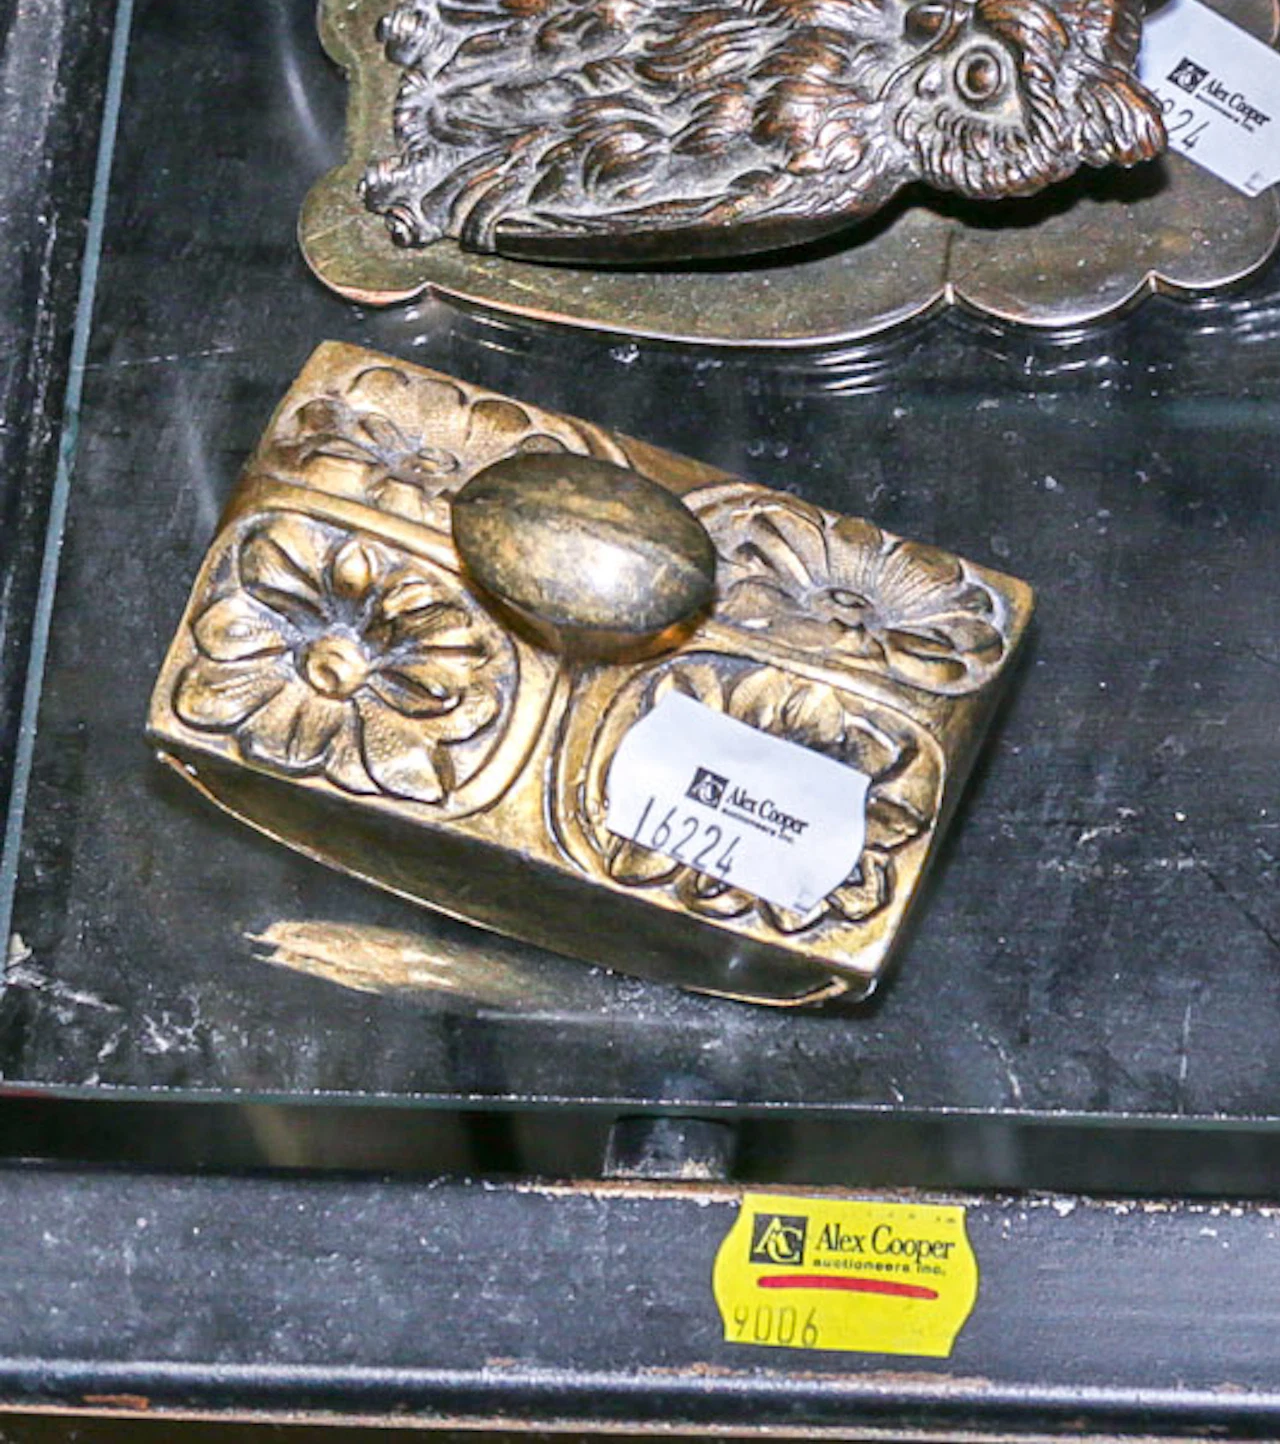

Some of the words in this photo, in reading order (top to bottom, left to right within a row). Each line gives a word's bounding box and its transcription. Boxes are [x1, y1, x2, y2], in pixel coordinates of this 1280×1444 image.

[1202, 78, 1232, 106] Alex
[1229, 92, 1271, 127] Cooper
[725, 786, 758, 814] Alex
[758, 798, 809, 836] Cooper
[633, 796, 741, 877] 16224
[813, 1223, 866, 1253] Alex
[871, 1223, 956, 1264] Cooper
[733, 1304, 820, 1348] 9006
